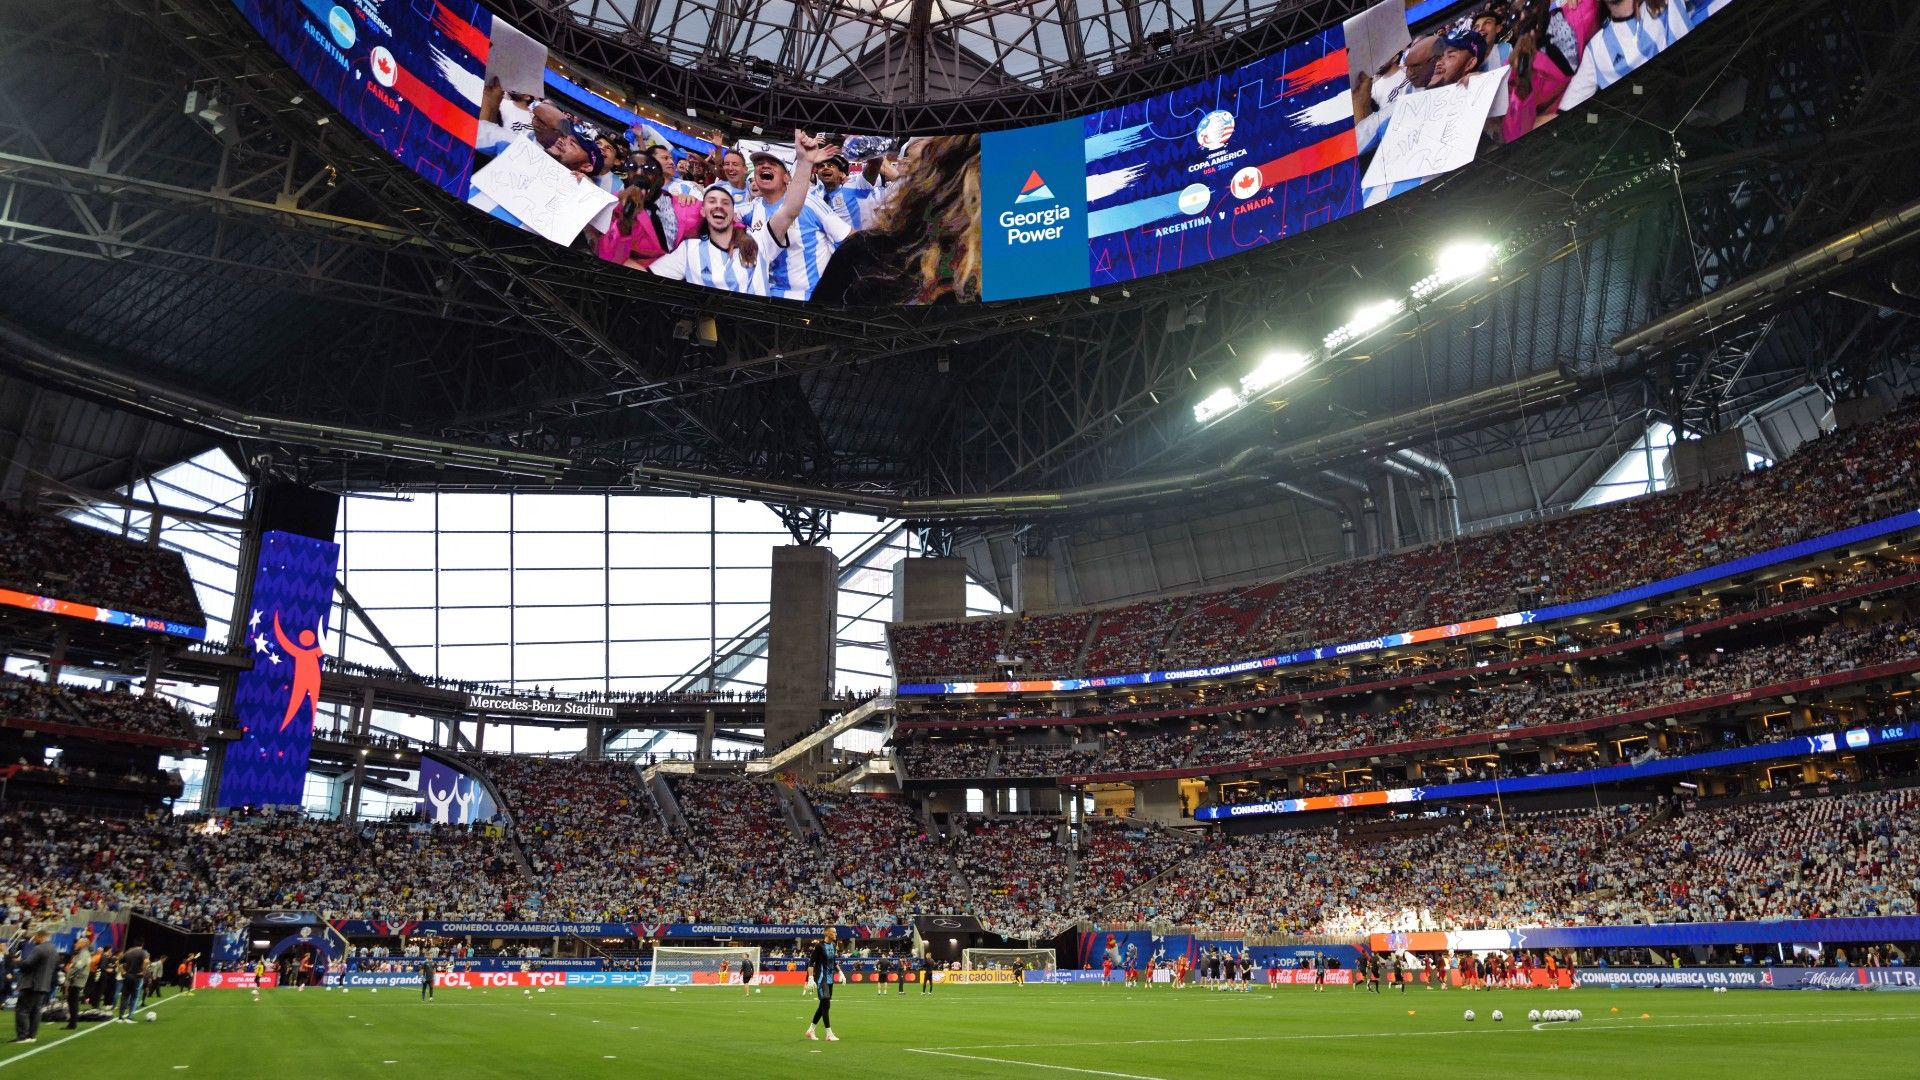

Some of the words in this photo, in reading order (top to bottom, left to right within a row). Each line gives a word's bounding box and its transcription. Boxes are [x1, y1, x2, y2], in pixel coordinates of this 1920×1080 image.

[304, 18, 350, 72] ARGENTINA
[367, 80, 400, 115] CANADA
[1188, 160, 1210, 173] COPA
[1211, 148, 1248, 166] AMERICA
[1203, 167, 1216, 175] USA
[999, 204, 1070, 228] Georgia
[1155, 215, 1212, 238] ARGENTINA
[1233, 195, 1275, 216] CANADA
[1008, 225, 1064, 246] Power
[146, 619, 165, 632] USA
[166, 623, 192, 635] 2024
[1336, 639, 1381, 654] CONMEBOL
[1164, 669, 1210, 680] CONMEBOL
[1210, 667, 1230, 676] COPA
[1230, 660, 1263, 673] AMERICA
[1262, 657, 1278, 667] USA
[1090, 679, 1106, 687] USA
[469, 695, 561, 713] Mercedes-Benz
[564, 701, 614, 716] Stadium
[1881, 727, 1904, 740] ARG
[1230, 803, 1274, 815] CONMEBOL
[442, 923, 494, 932] CONMEBOL
[495, 923, 520, 932] COPA
[521, 924, 560, 933] AMERICA
[562, 925, 579, 933] USA
[580, 925, 601, 933] 2024
[691, 925, 738, 933] CONMEBOL
[738, 925, 759, 934] COPA
[760, 926, 795, 934] AMERICA
[795, 926, 810, 934] USA
[351, 975, 374, 985] Cree
[375, 977, 388, 985] en
[434, 972, 471, 987] TCL
[480, 972, 519, 987] TCL
[527, 972, 566, 986] TCL
[568, 974, 606, 984] BYD
[611, 974, 649, 984] BYD
[654, 974, 690, 984] BYD
[1582, 972, 1634, 983] CONMEBOL
[1634, 972, 1660, 983] COPA
[1660, 972, 1704, 984] AMERICA
[1707, 972, 1728, 984] USA
[1729, 972, 1755, 984] 2024
[1801, 971, 1855, 989] Michelob
